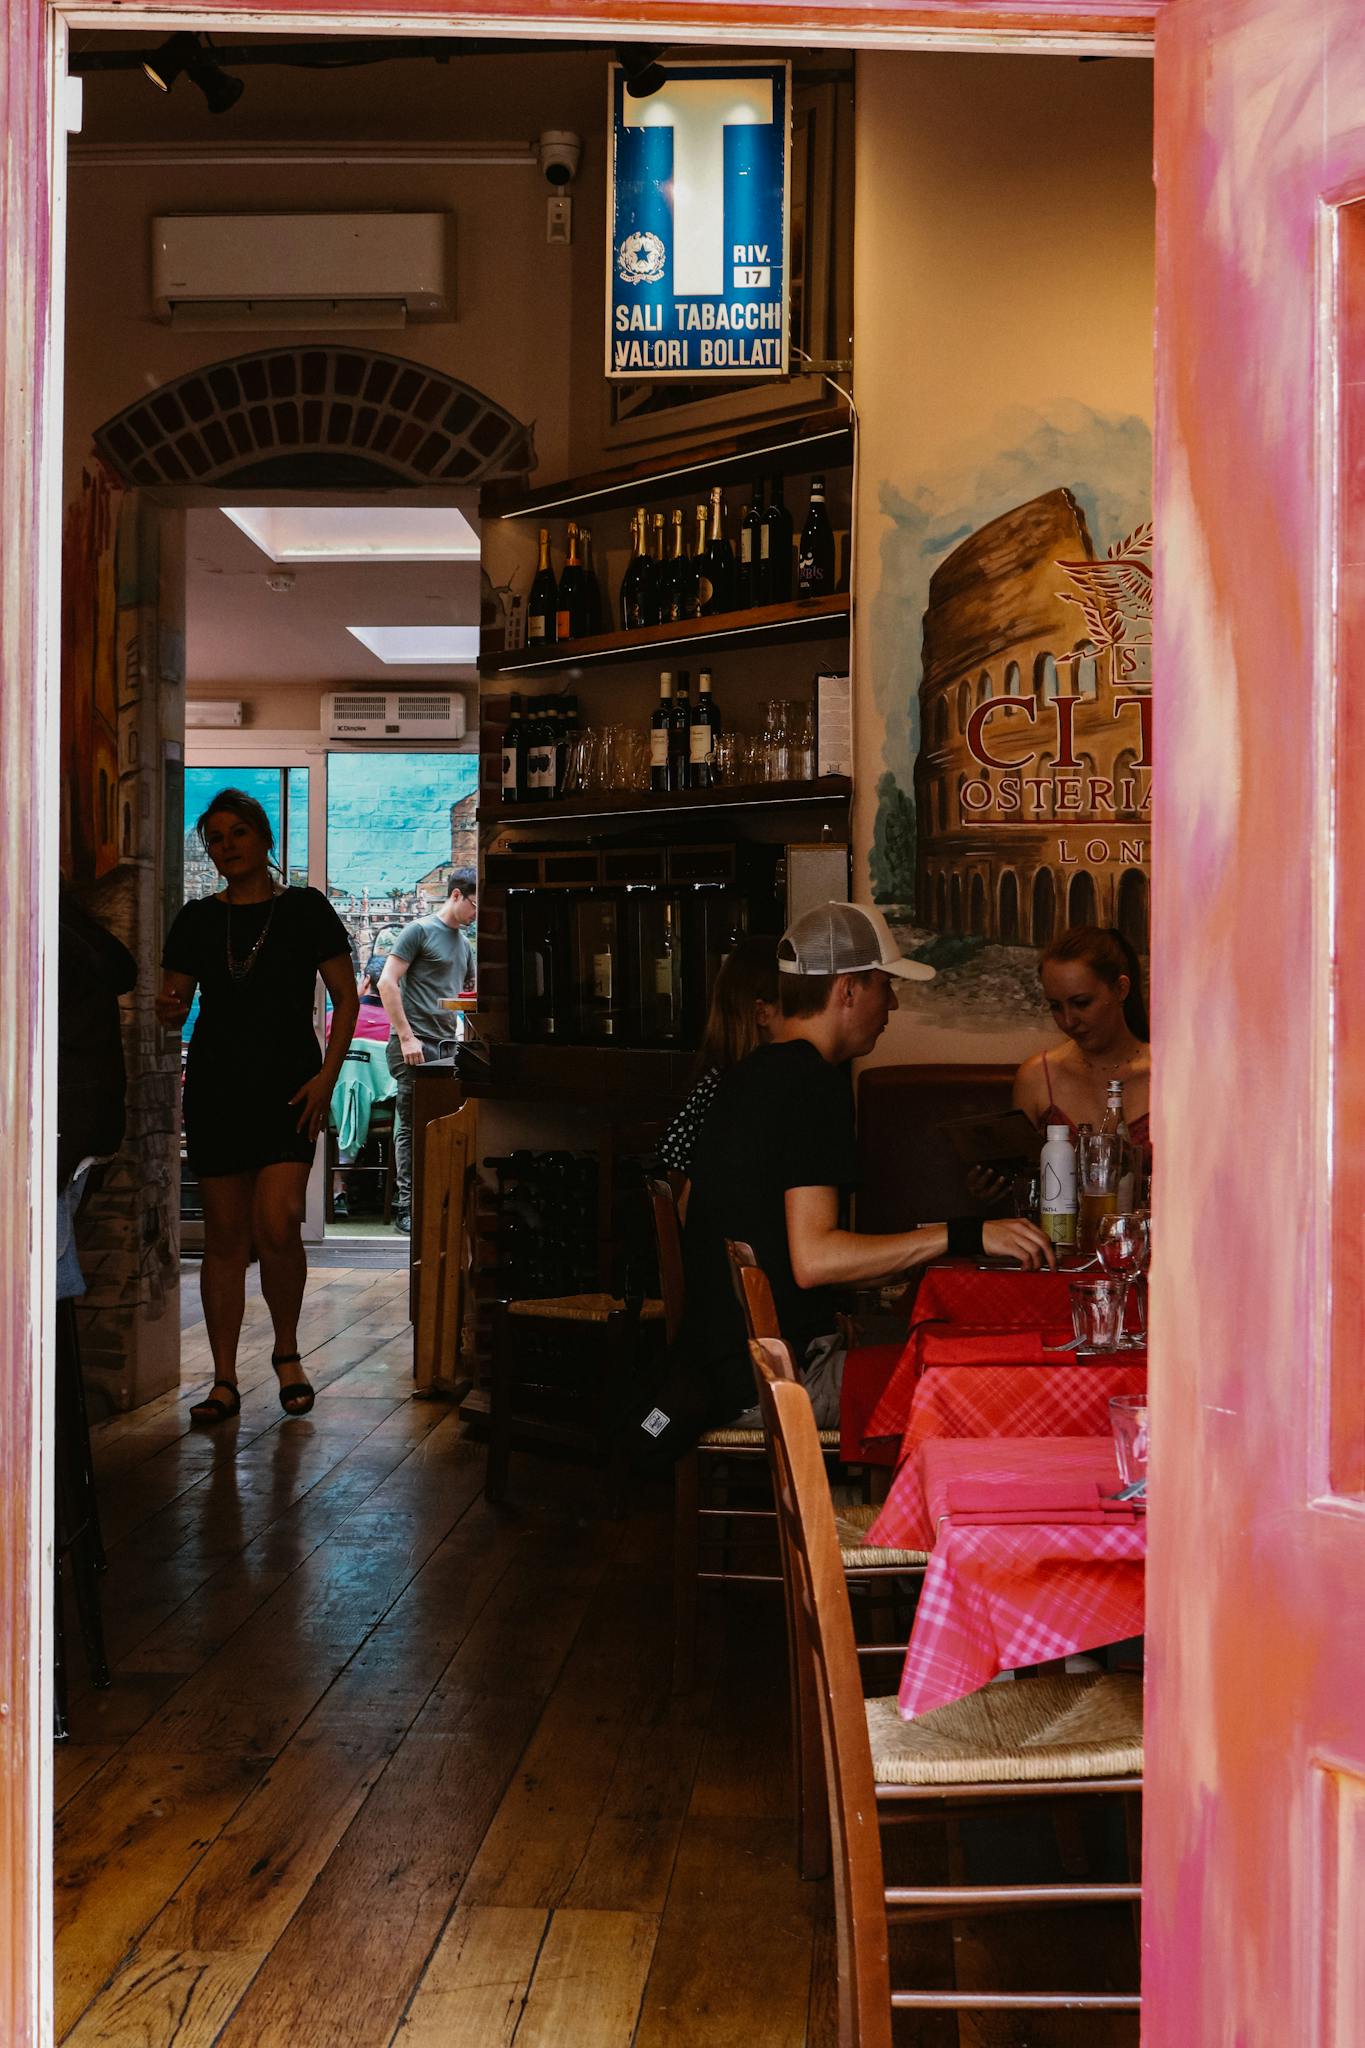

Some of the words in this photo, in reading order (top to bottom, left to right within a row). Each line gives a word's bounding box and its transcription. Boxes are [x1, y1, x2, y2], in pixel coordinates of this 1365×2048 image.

[623, 78, 774, 296] T
[733, 245, 771, 263] RIV.
[744, 271, 762, 285] 17
[615, 303, 663, 332] SALI
[675, 302, 781, 331] TABACCHI
[615, 339, 688, 368] VALORI
[700, 338, 781, 367] BOLLATI
[1058, 839, 1144, 865] LON
